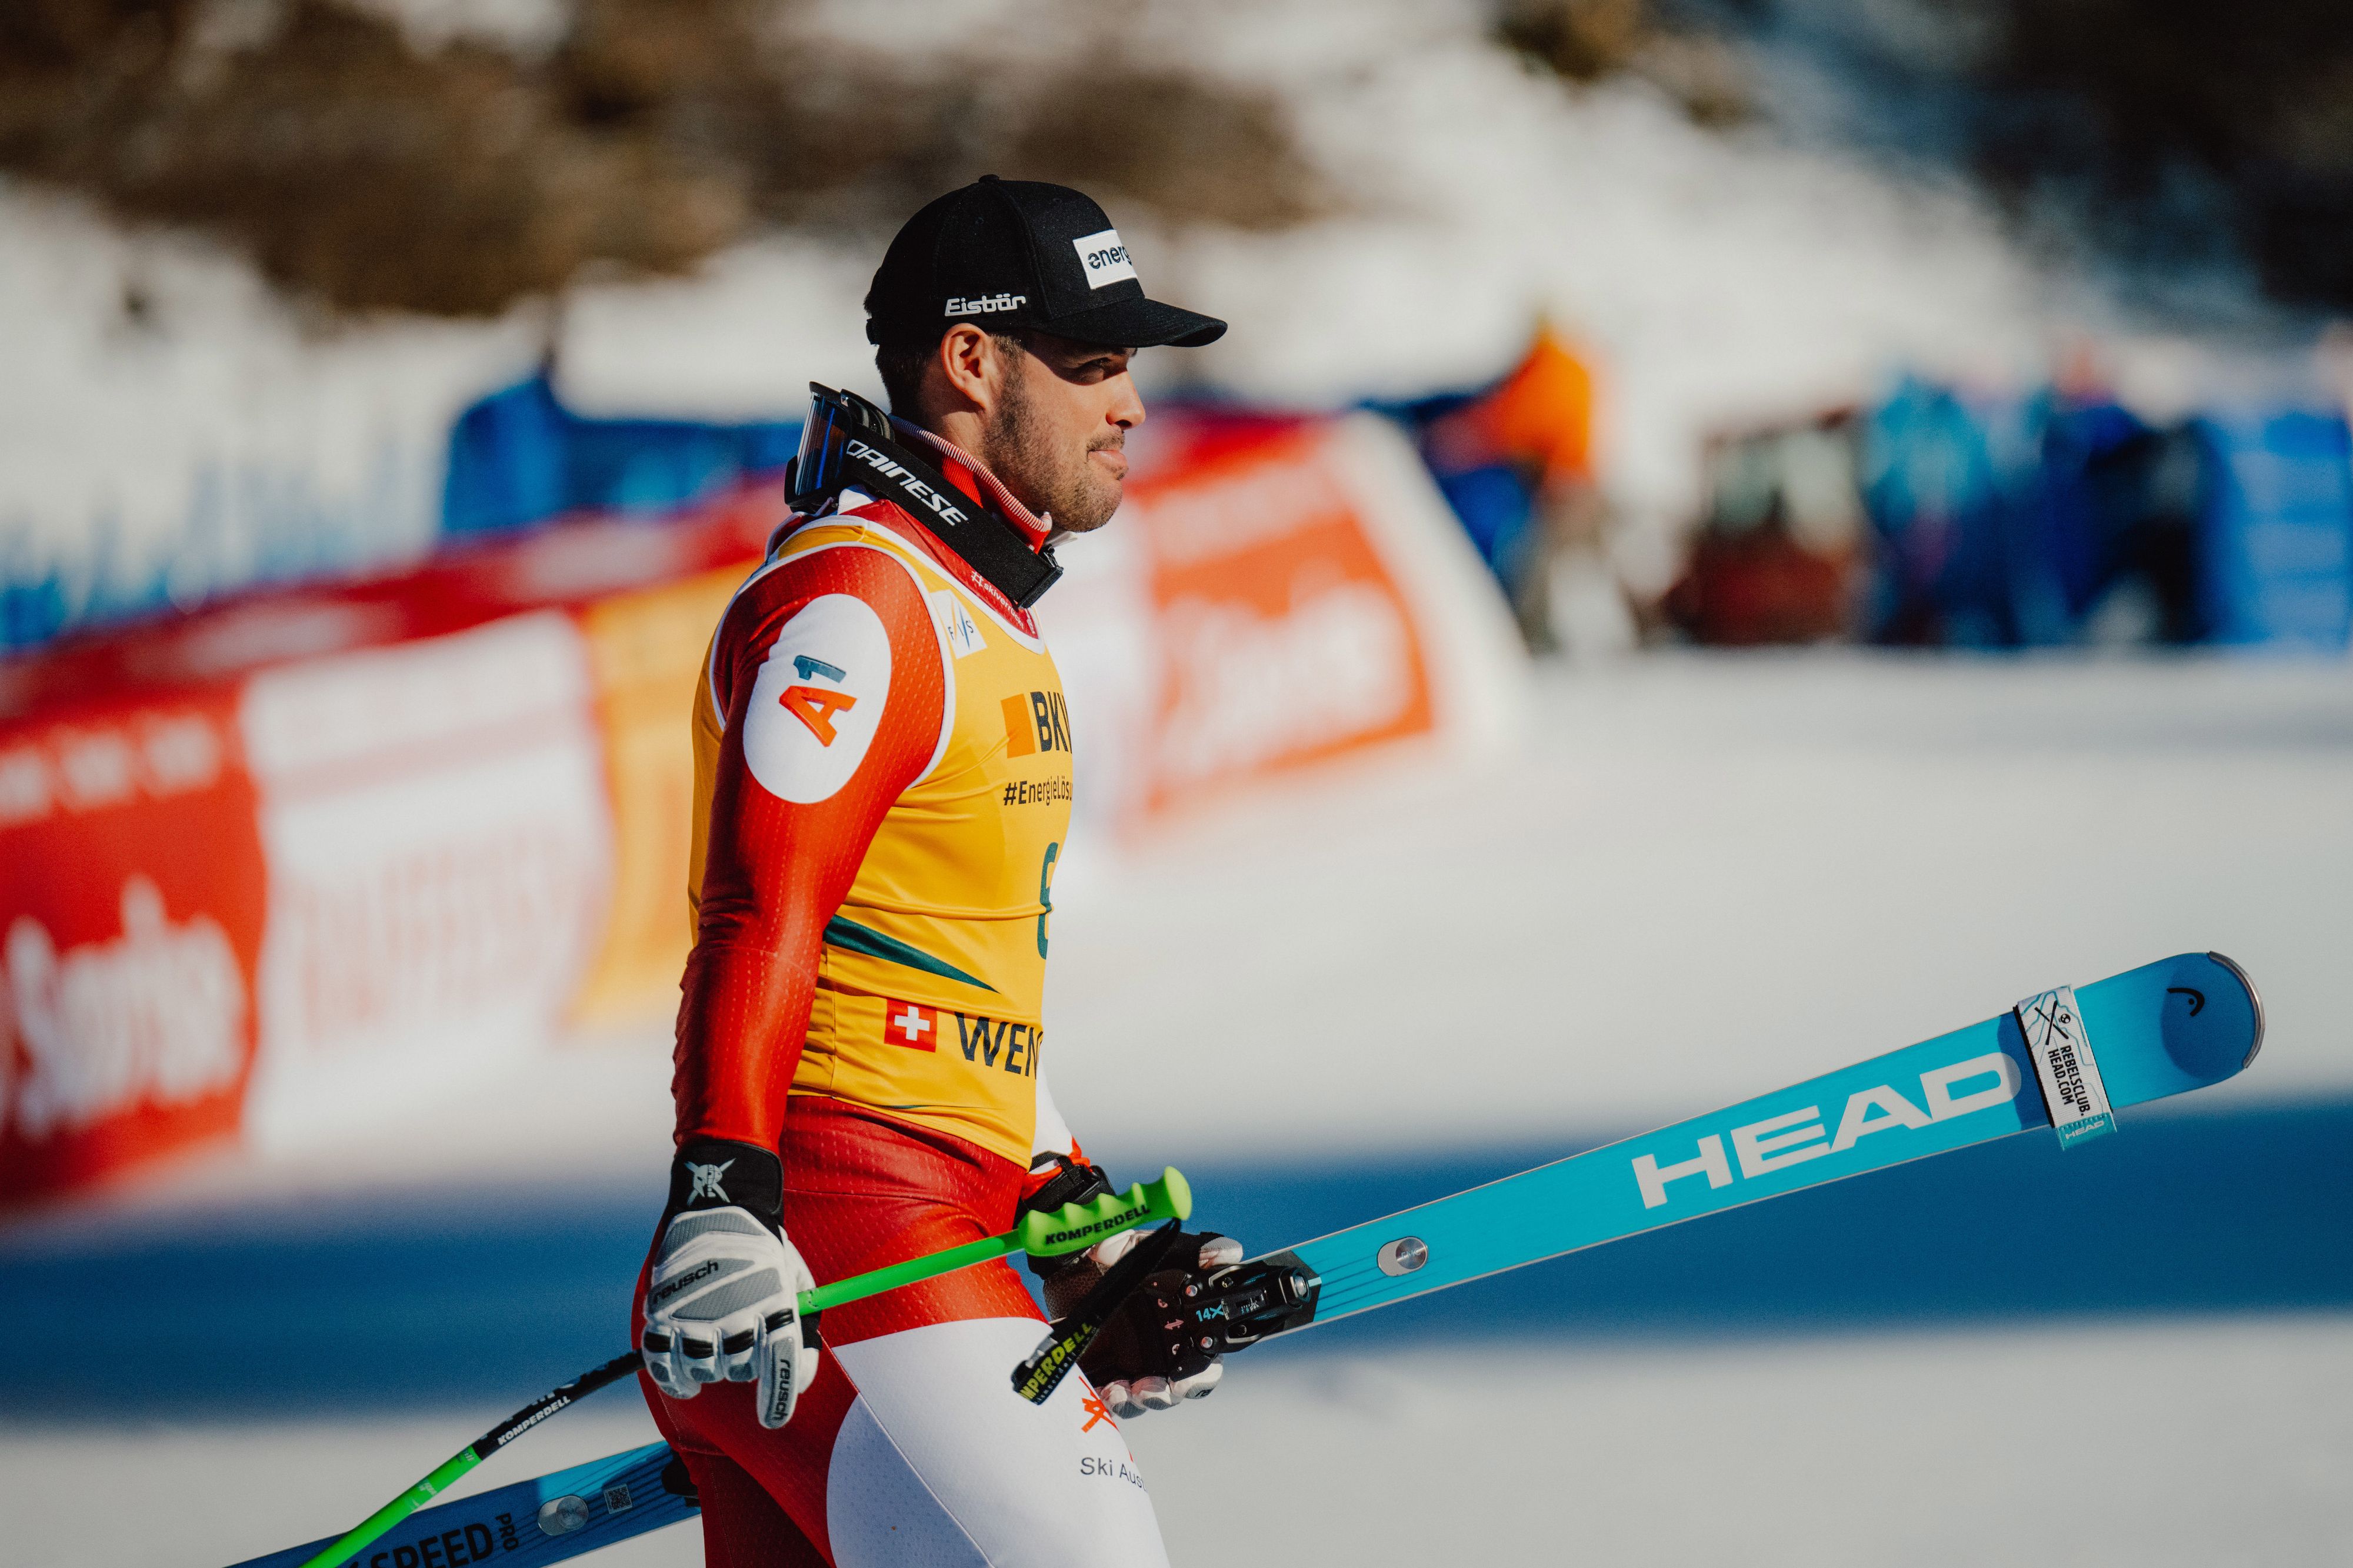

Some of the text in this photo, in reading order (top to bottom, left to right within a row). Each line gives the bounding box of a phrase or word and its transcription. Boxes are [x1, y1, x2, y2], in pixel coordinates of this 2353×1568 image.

[944, 293, 1026, 317] Eisbär
[846, 439, 969, 526] DAINESE
[779, 654, 858, 748] A1
[954, 1011, 1044, 1080] WEN
[2048, 1048, 2075, 1106] HEAD.COM
[2060, 1045, 2091, 1116] REBELSCLUB.
[1631, 1052, 2022, 1209] HEAD
[2065, 1120, 2105, 1140] HEAD
[1045, 1204, 1151, 1245] KOMPERDELL
[653, 1260, 718, 1305] reusch
[1195, 1304, 1224, 1322] 14X
[1018, 1322, 1092, 1401] MPERDELL
[772, 1358, 791, 1421] reusch
[498, 1395, 571, 1446] KOMPERDELL
[1080, 1457, 1113, 1476] Ski
[495, 1512, 519, 1551] PRO
